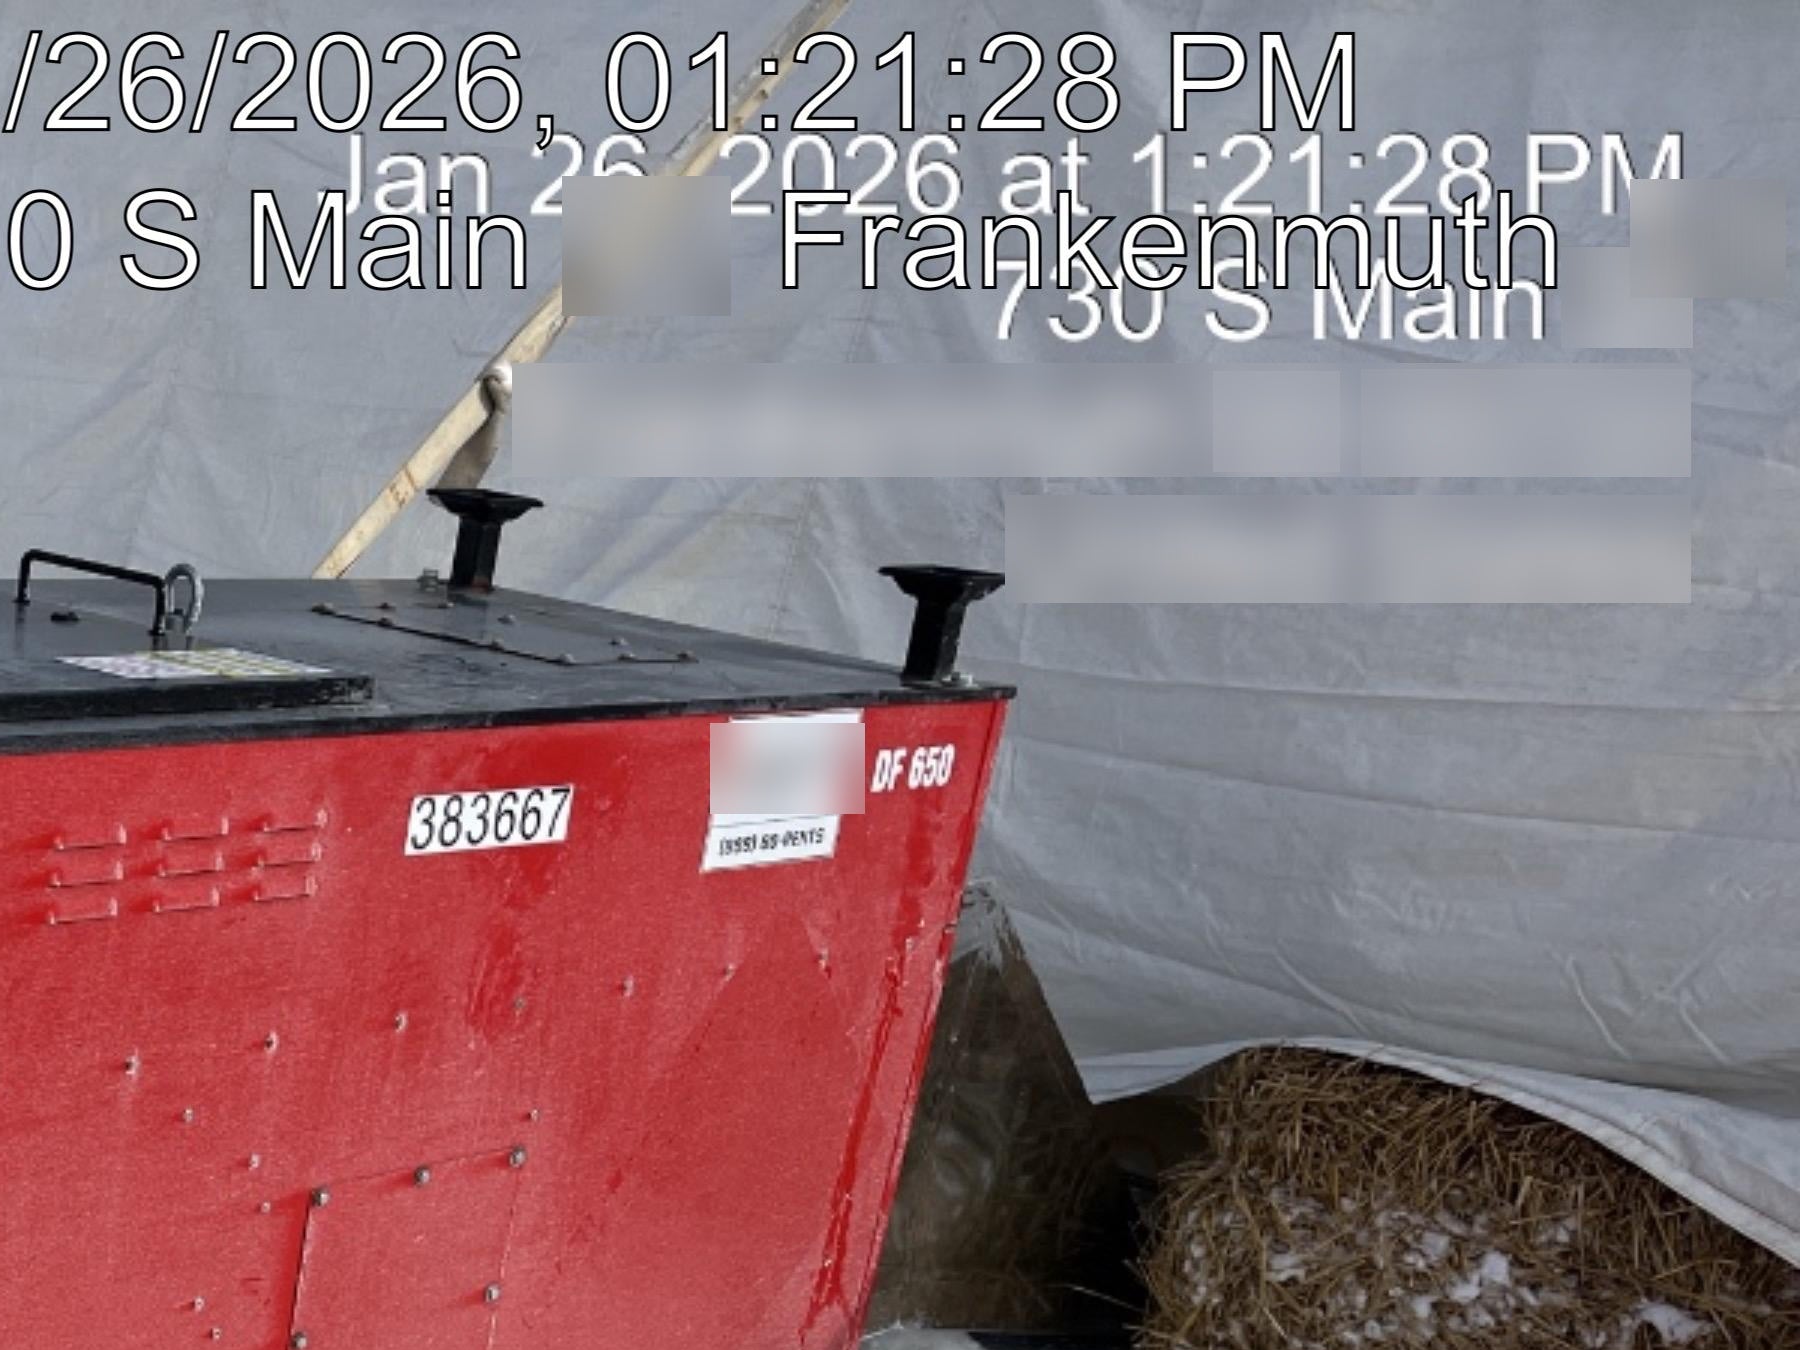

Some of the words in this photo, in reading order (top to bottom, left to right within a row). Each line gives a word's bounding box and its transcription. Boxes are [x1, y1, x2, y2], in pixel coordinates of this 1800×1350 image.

[869, 746, 907, 793] DF
[908, 743, 956, 790] 650
[409, 787, 572, 850] 383667
